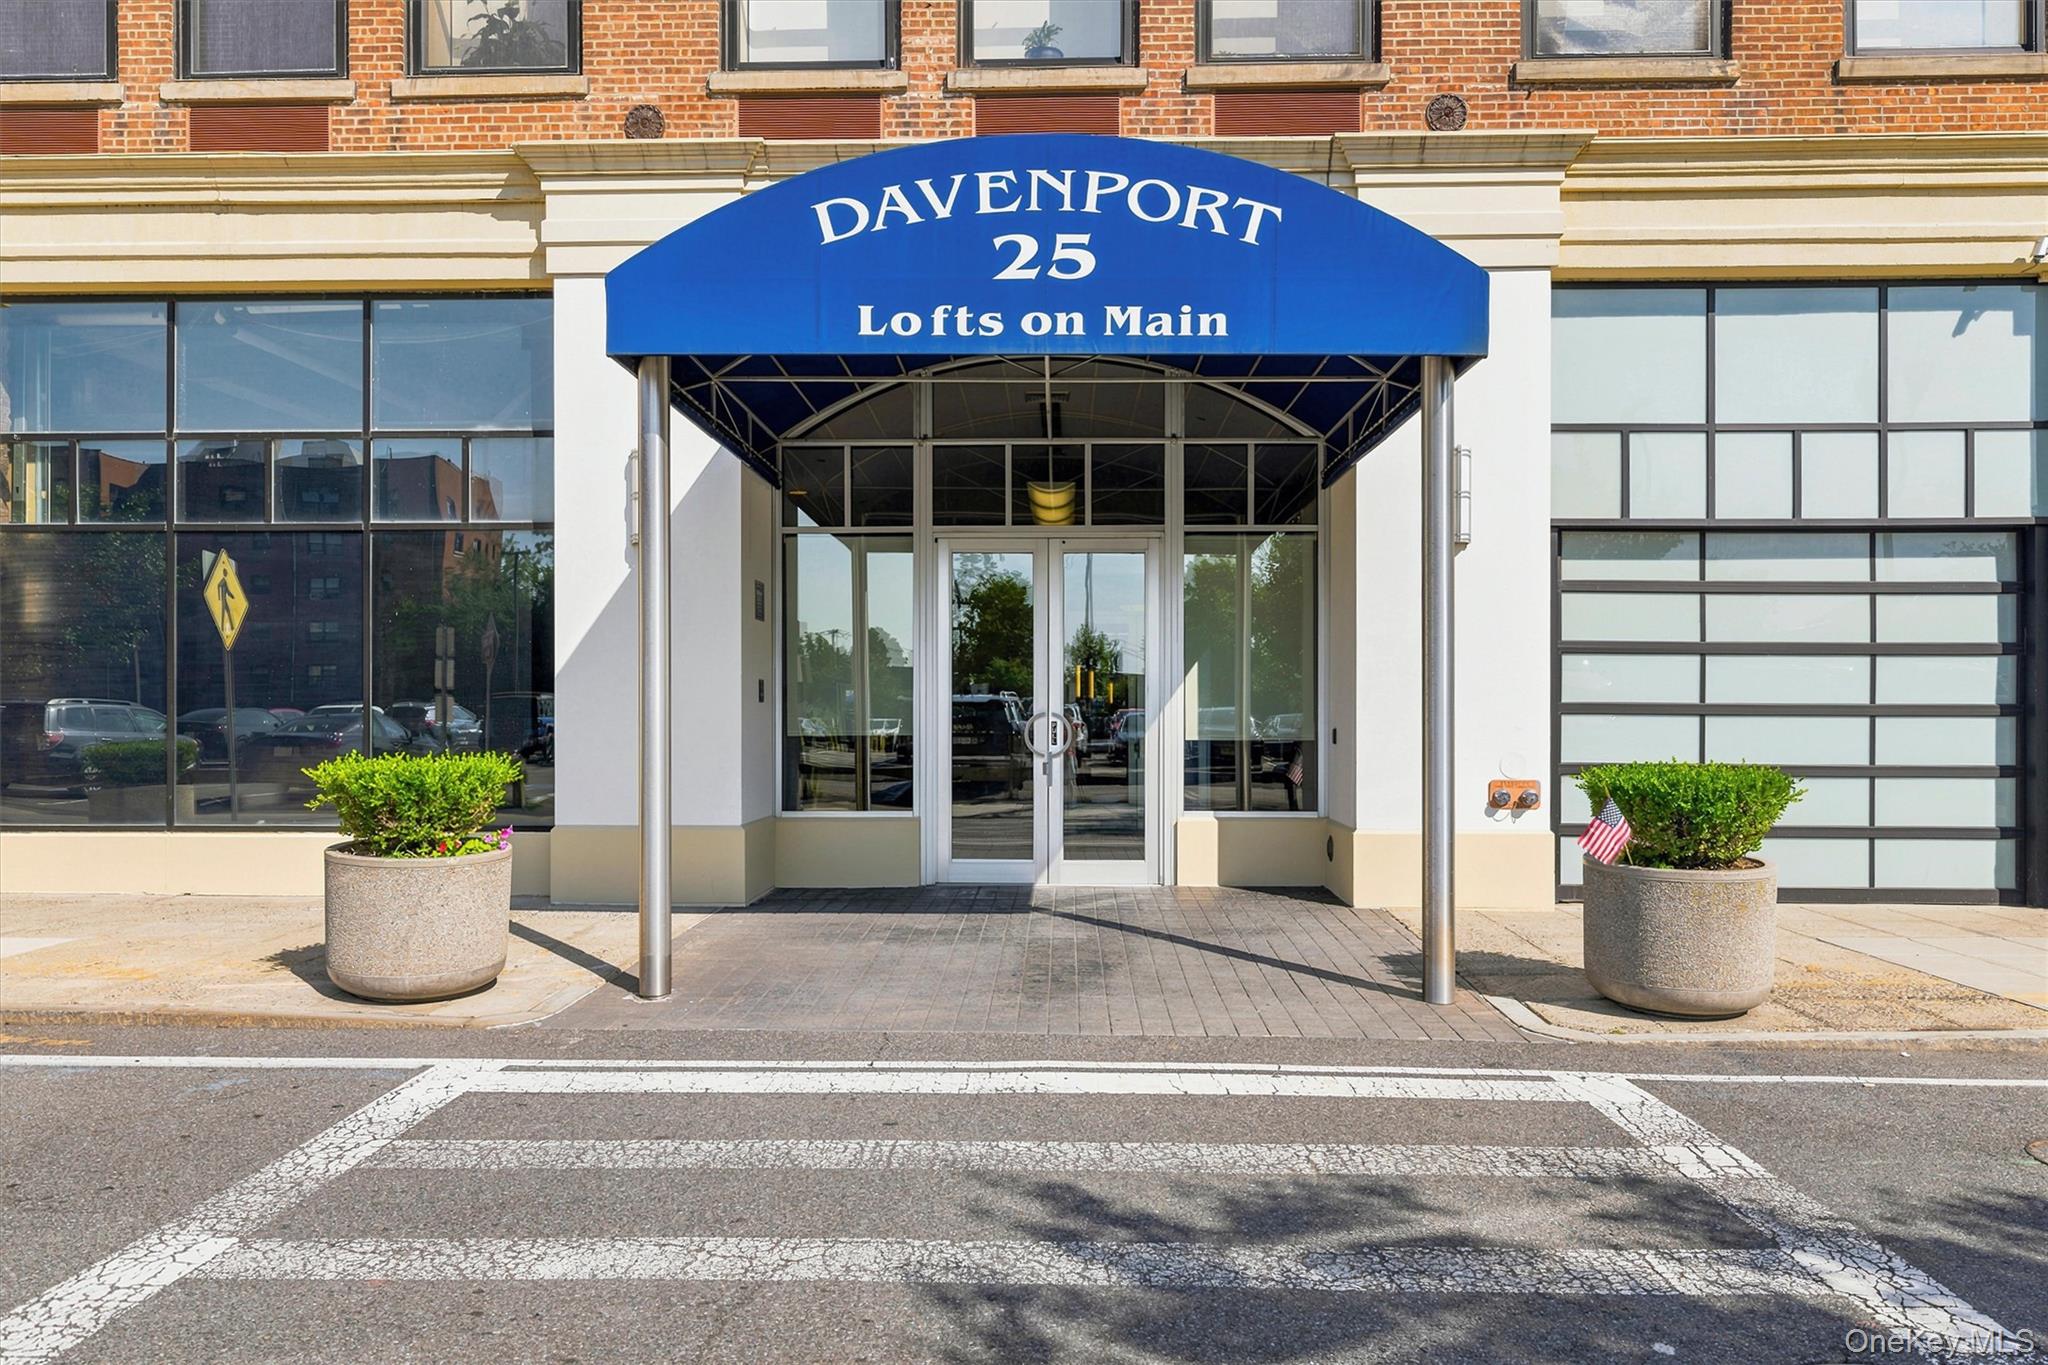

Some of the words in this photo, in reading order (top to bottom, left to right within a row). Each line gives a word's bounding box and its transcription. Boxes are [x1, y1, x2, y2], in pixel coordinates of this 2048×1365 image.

[811, 169, 1282, 245] DAVENPORT
[993, 233, 1096, 280] 25
[858, 305, 1004, 336] Lofts
[1020, 312, 1086, 336] on
[1104, 305, 1228, 336] Main
